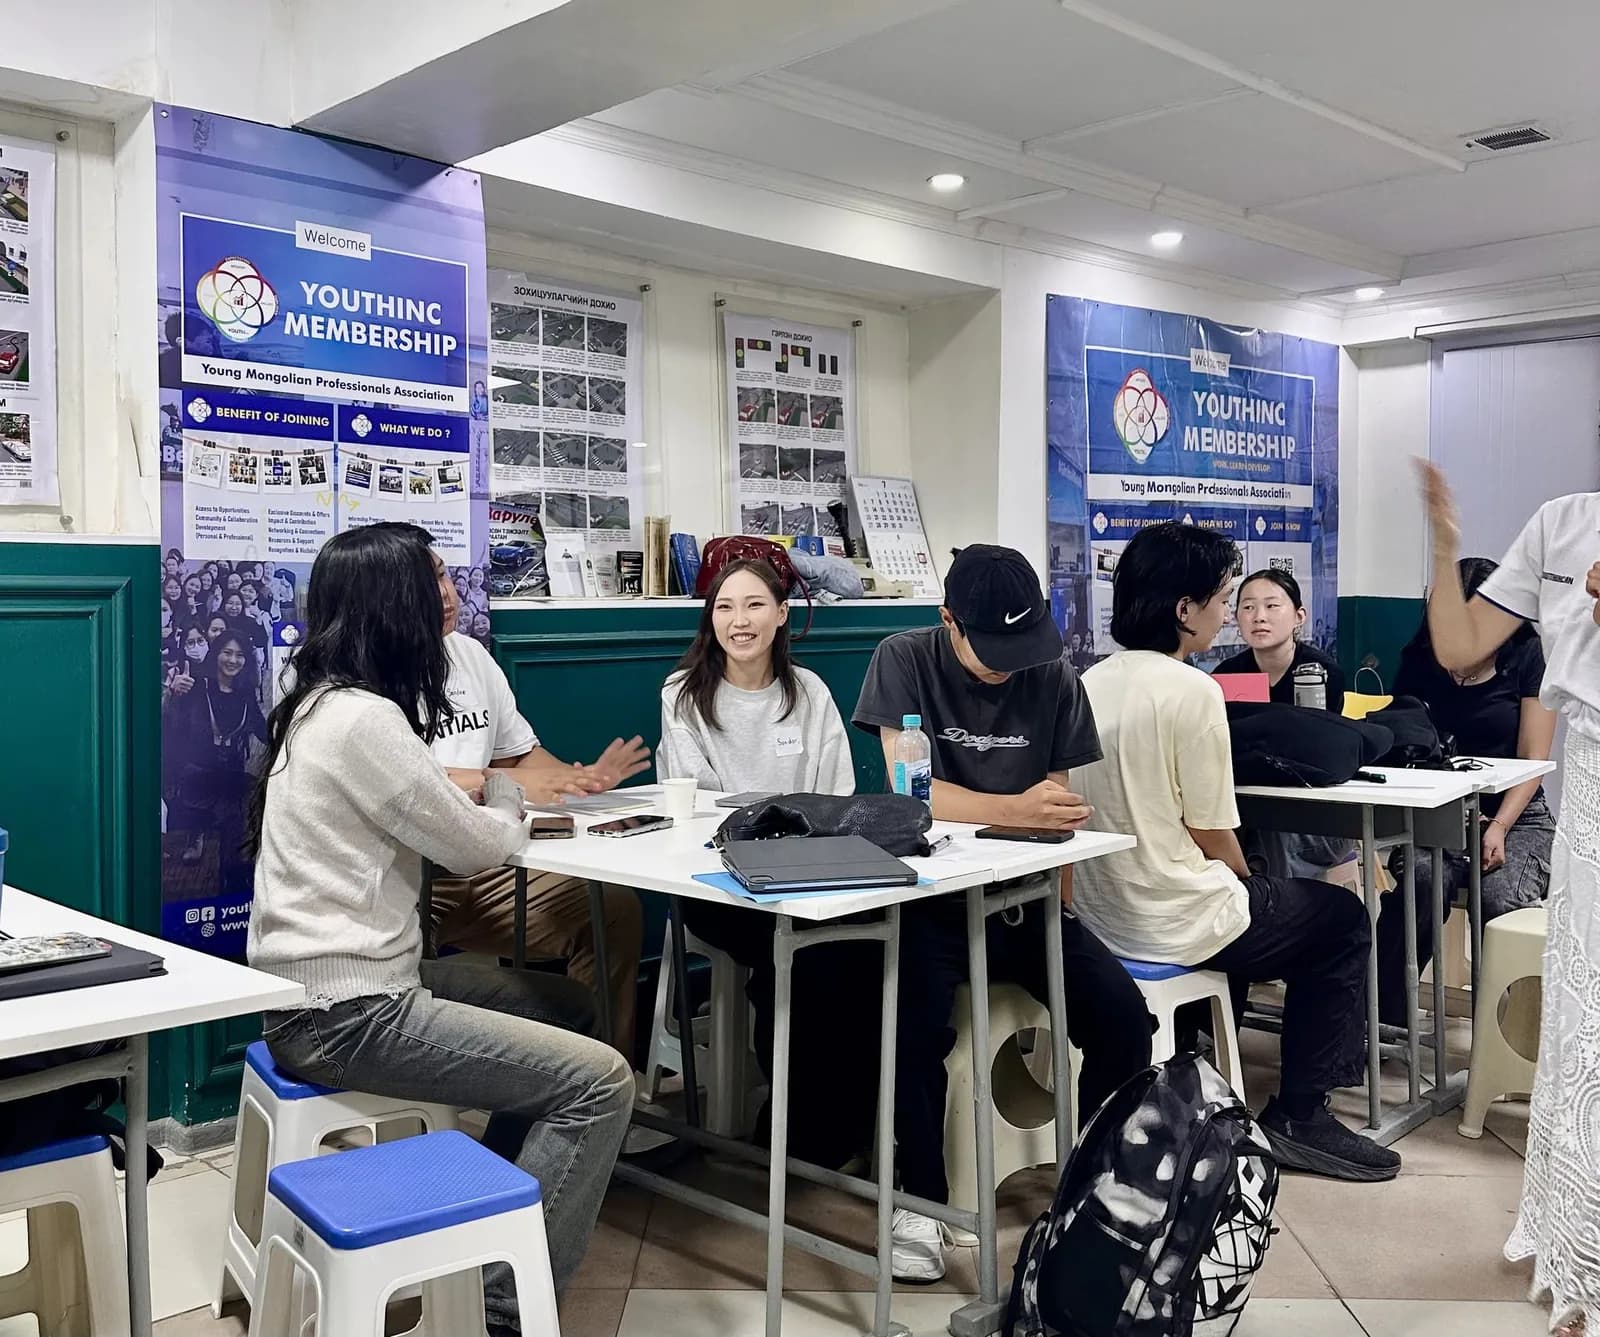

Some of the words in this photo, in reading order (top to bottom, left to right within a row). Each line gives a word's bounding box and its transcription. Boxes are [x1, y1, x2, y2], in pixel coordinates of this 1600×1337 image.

[304, 228, 366, 251] Welcome
[299, 281, 442, 326] YOUTHINC
[590, 299, 616, 310] ДОХИО
[283, 312, 457, 357] MEMBERSHIP
[201, 363, 241, 380] Young
[245, 368, 312, 385] Mongolian
[316, 376, 391, 395] Professionals
[394, 386, 454, 402] Association
[216, 407, 262, 420] BENEFIT
[264, 411, 280, 422] OF
[281, 413, 330, 427] JOINING
[1193, 391, 1286, 426] YOUTHINC
[380, 423, 408, 435] WHAT
[410, 426, 425, 436] WE
[427, 428, 442, 437] DO
[445, 429, 451, 438] ?
[1183, 426, 1296, 460] MEMBERSHIP
[1120, 479, 1145, 495] Young
[1147, 481, 1196, 496] Mongolian
[937, 727, 1030, 752] Dodgers
